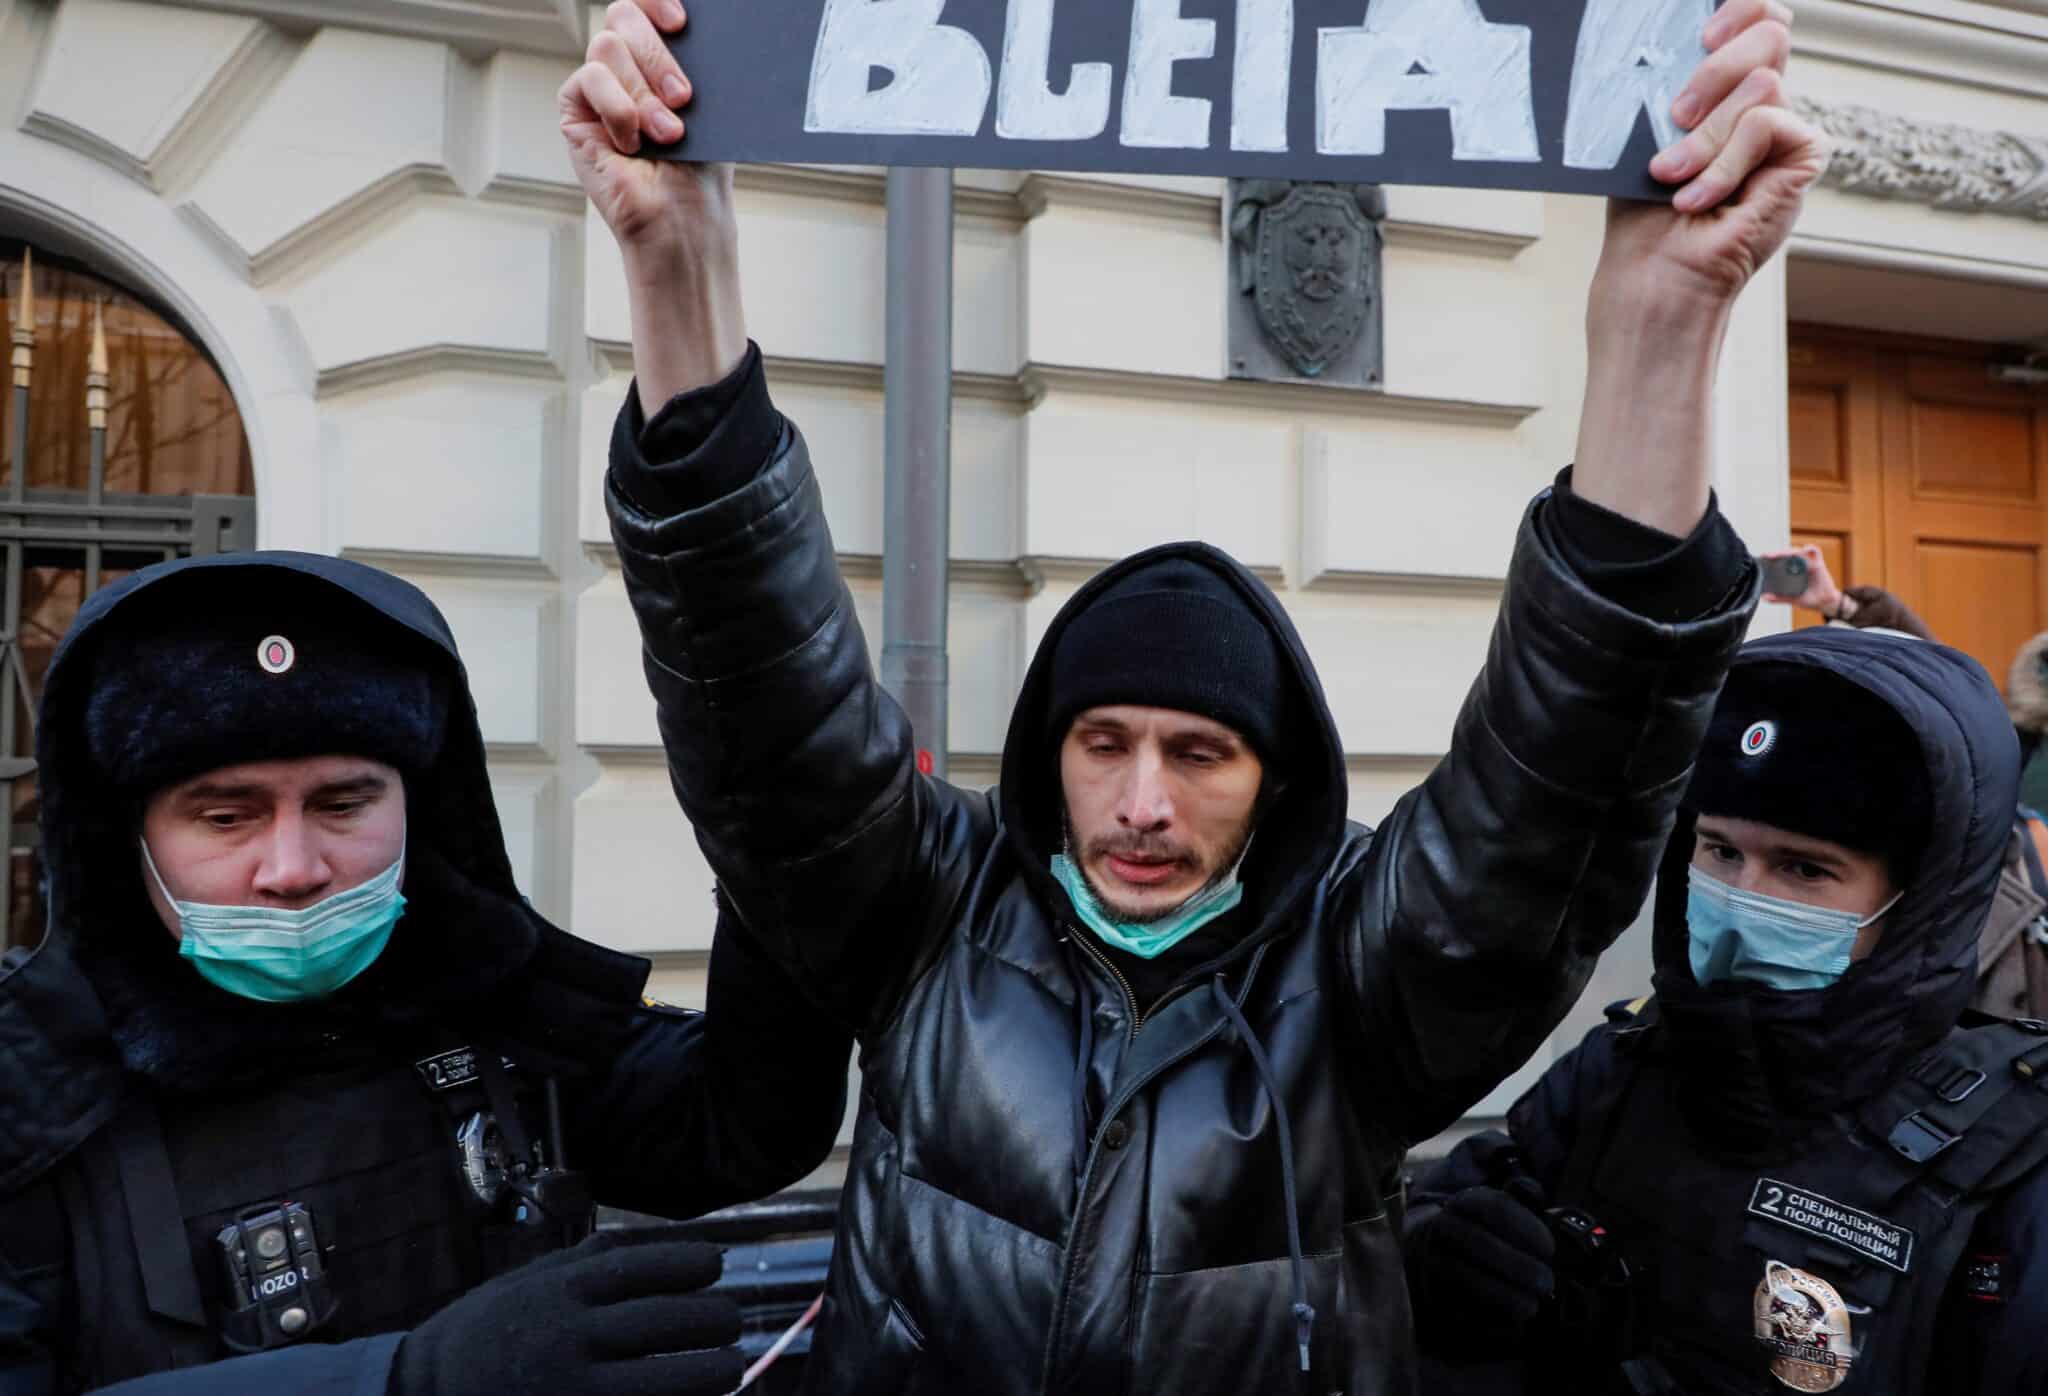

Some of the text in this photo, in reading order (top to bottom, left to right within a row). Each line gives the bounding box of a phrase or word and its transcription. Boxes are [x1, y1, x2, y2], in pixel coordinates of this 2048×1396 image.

[428, 1063, 447, 1085] 2
[1760, 1187, 1900, 1247] 2 СПЕЦИАЛЬНЫЙ
[1784, 1206, 1898, 1261] ПОЛК ПОЛИЦИИ
[1776, 1342, 1836, 1366] ОЛИЦИЯ
